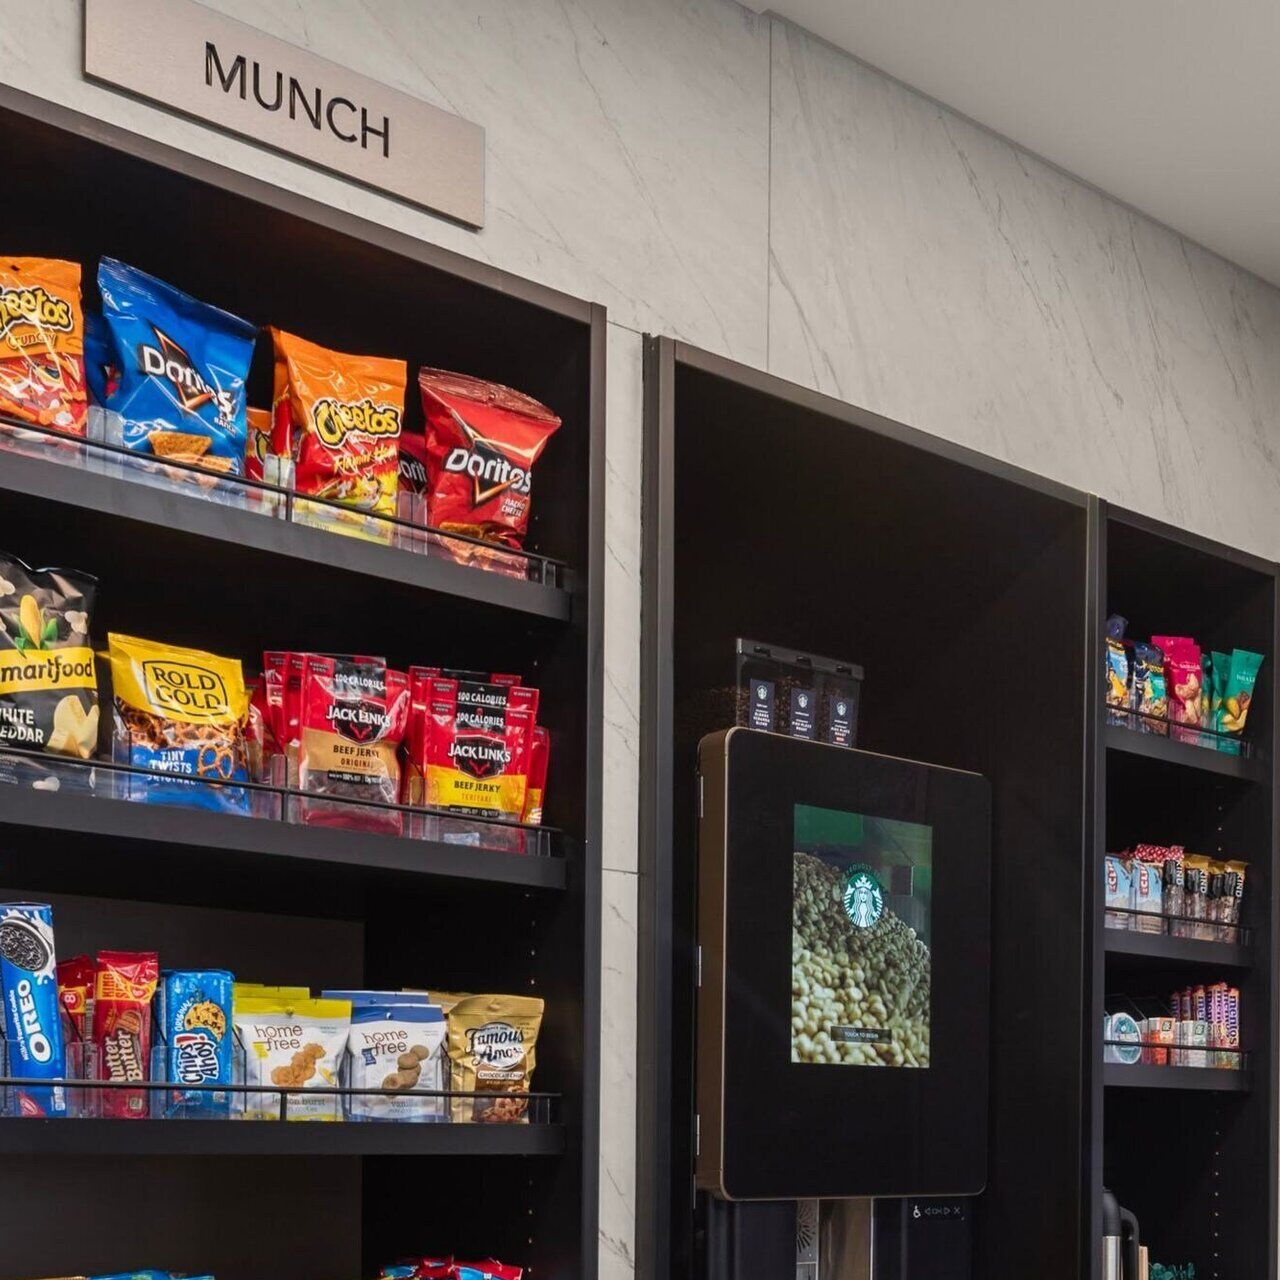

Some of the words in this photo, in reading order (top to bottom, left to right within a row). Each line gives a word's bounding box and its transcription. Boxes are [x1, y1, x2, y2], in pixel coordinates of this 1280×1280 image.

[205, 41, 390, 159] MUNCH
[143, 344, 234, 415] Doritos
[314, 399, 400, 448] Cheetos
[446, 449, 533, 492] Doritos
[155, 666, 216, 691] ROLD
[349, 674, 386, 690] CALORIES
[156, 685, 220, 710] GOLD
[458, 692, 470, 704] 100
[471, 692, 507, 706] CALORIES
[327, 705, 357, 722] JACK
[457, 712, 469, 723] 100
[470, 713, 504, 726] CALORIES
[160, 750, 185, 762] TINY
[333, 745, 355, 757] BEEF
[448, 743, 478, 759] JACK
[150, 760, 192, 774] TWISTS
[454, 780, 475, 791] BEEF
[475, 782, 501, 794] JERKY
[1176, 860, 1184, 886] KIND
[1200, 870, 1208, 894] KIND
[1236, 872, 1244, 898] KIND
[18, 979, 53, 1064] OREO
[254, 1025, 303, 1038] home
[1229, 995, 1237, 1045] mentos
[267, 1037, 300, 1051] free
[364, 1029, 408, 1045] home
[376, 1040, 407, 1057] free
[465, 1028, 524, 1053] Famous
[121, 1027, 143, 1082] Butter
[181, 1042, 203, 1084] Chips
